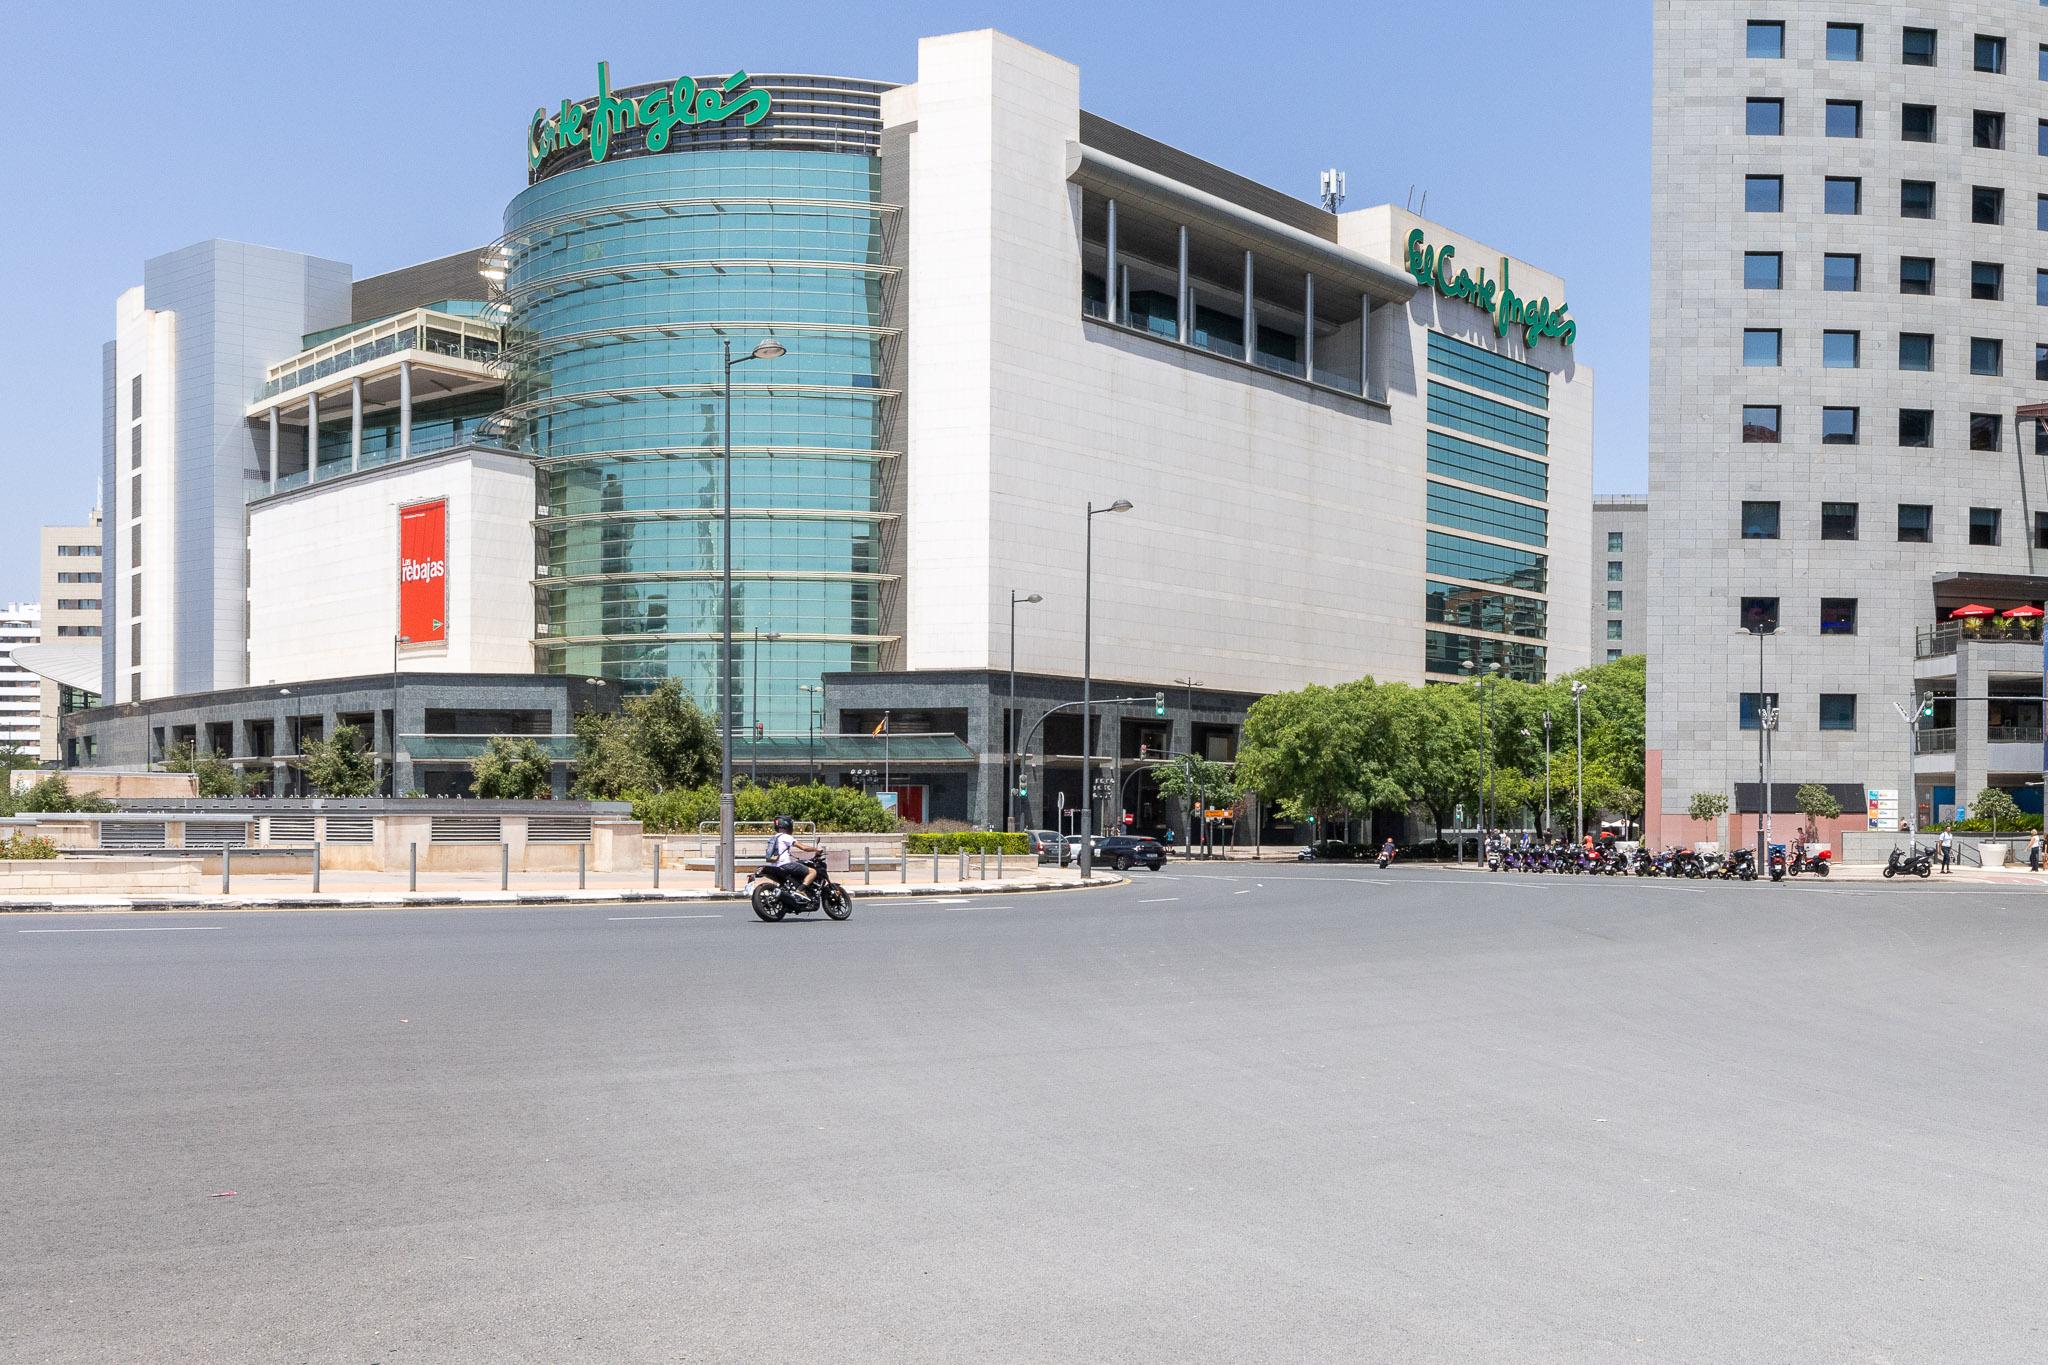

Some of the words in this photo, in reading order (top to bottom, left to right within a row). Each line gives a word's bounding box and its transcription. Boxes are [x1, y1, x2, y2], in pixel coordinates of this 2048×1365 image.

[529, 98, 588, 169] Corte
[589, 61, 772, 163] Inglés
[1404, 228, 1436, 287] El
[1434, 244, 1496, 314] Corte
[1493, 256, 1577, 348] Inglés
[402, 557, 445, 583] rebajas
